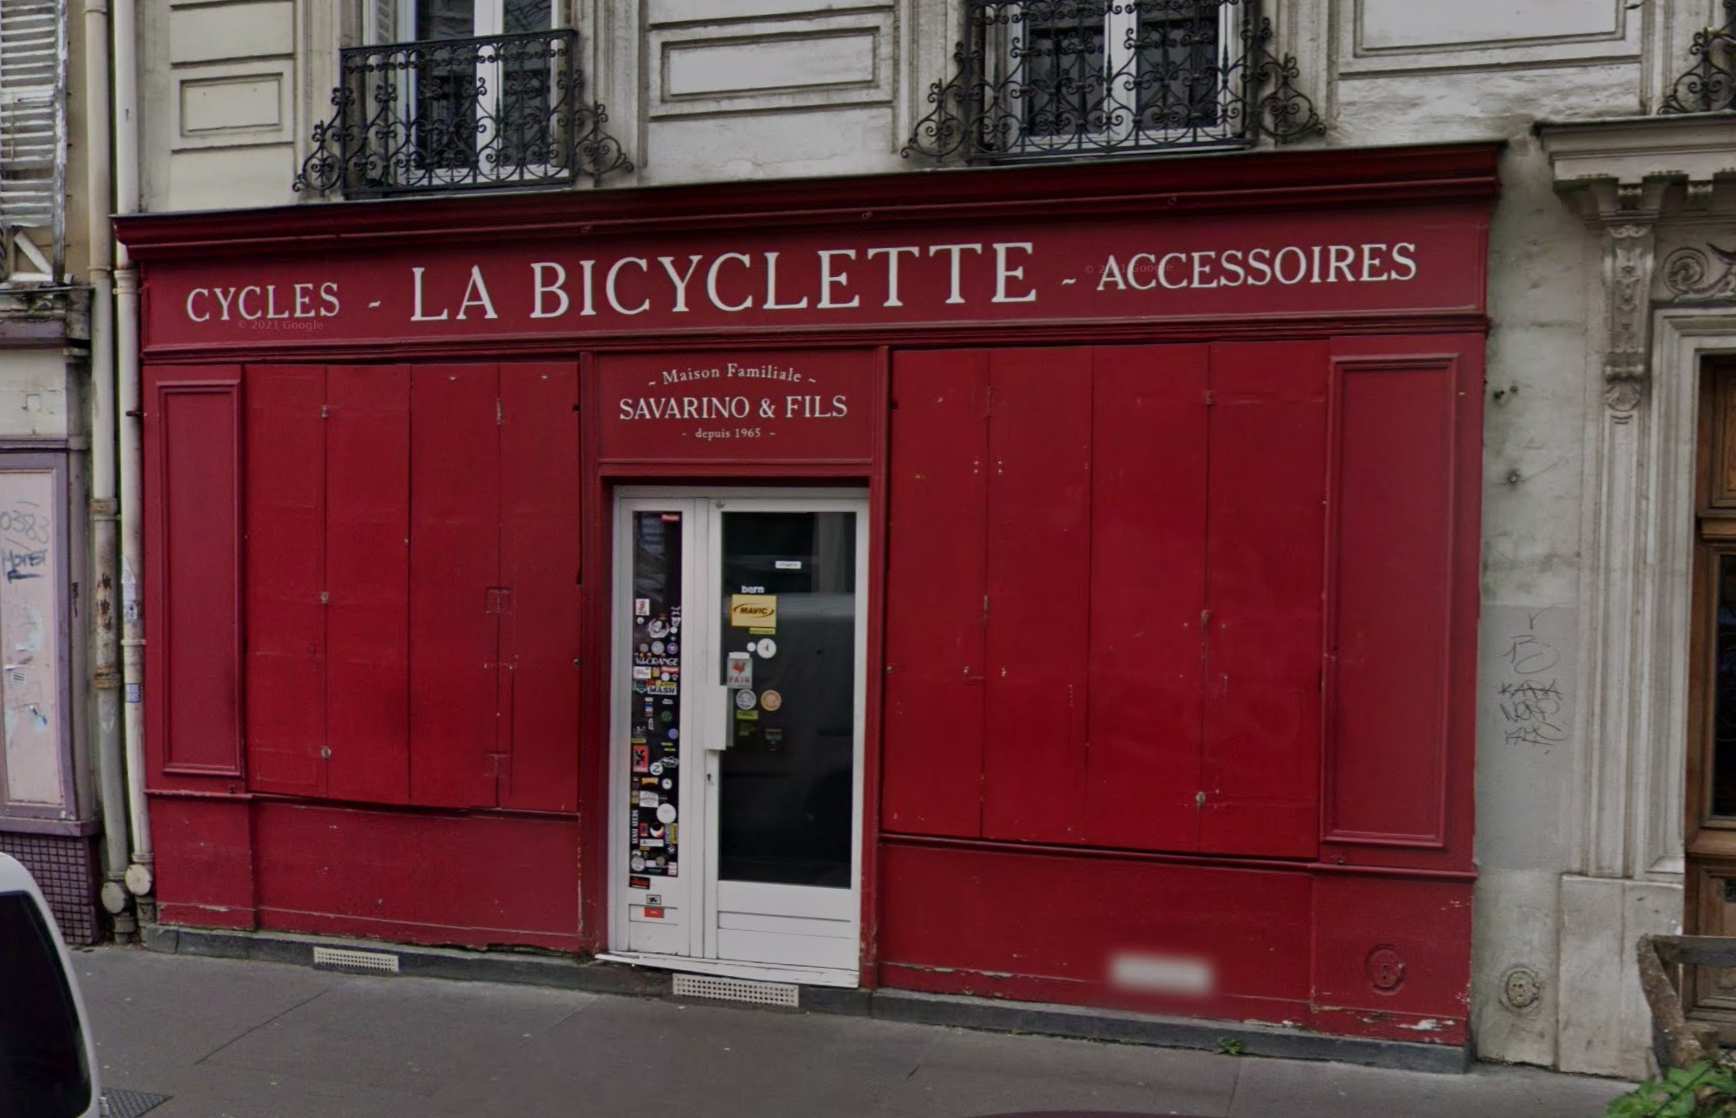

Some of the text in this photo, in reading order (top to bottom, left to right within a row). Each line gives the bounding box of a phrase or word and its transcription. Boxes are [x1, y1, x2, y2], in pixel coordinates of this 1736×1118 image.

[186, 281, 340, 322] CYCLES
[410, 265, 499, 322] LA
[529, 242, 1037, 319] BICYCLETTE
[1096, 242, 1418, 291] ACCESSOIRES
[662, 362, 802, 385] Maison Familiale
[619, 394, 848, 420] SAVARINO & FILS
[694, 427, 761, 441] depuis 1965
[739, 606, 769, 616] MAVIC
